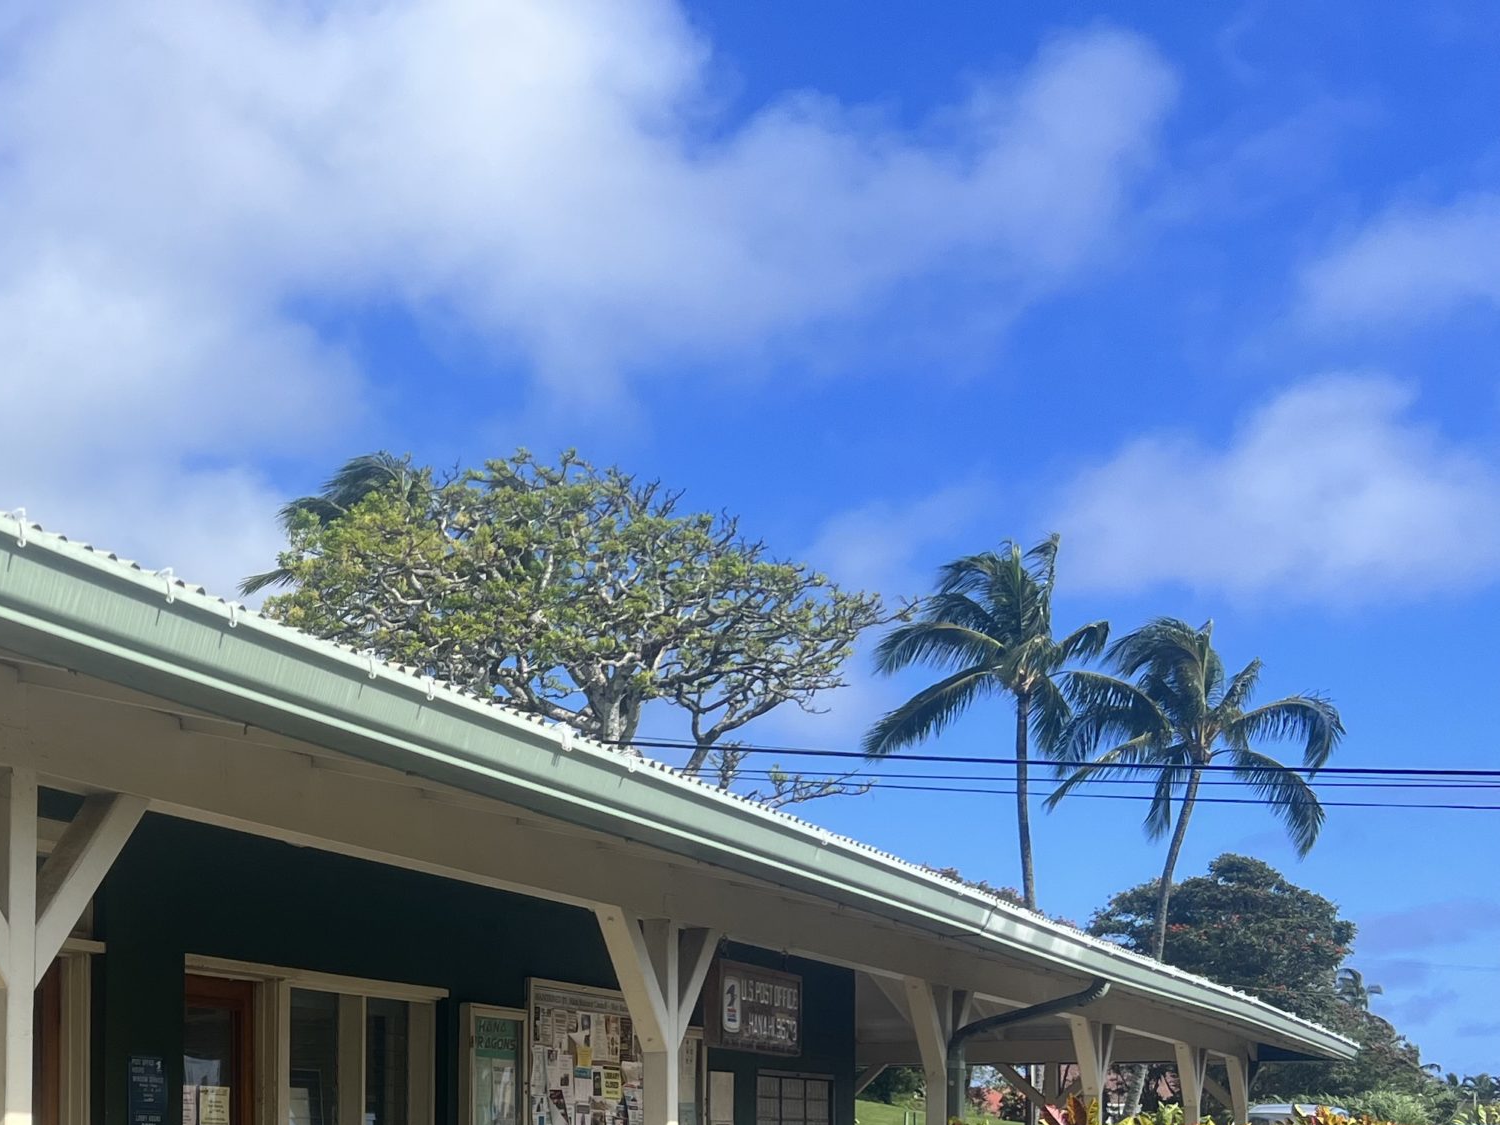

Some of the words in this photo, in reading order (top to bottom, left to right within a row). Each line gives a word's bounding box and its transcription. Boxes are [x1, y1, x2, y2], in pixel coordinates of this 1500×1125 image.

[756, 981, 773, 1005] POST
[774, 984, 798, 1010] OFFICE
[476, 1035, 517, 1050] RAGONS
